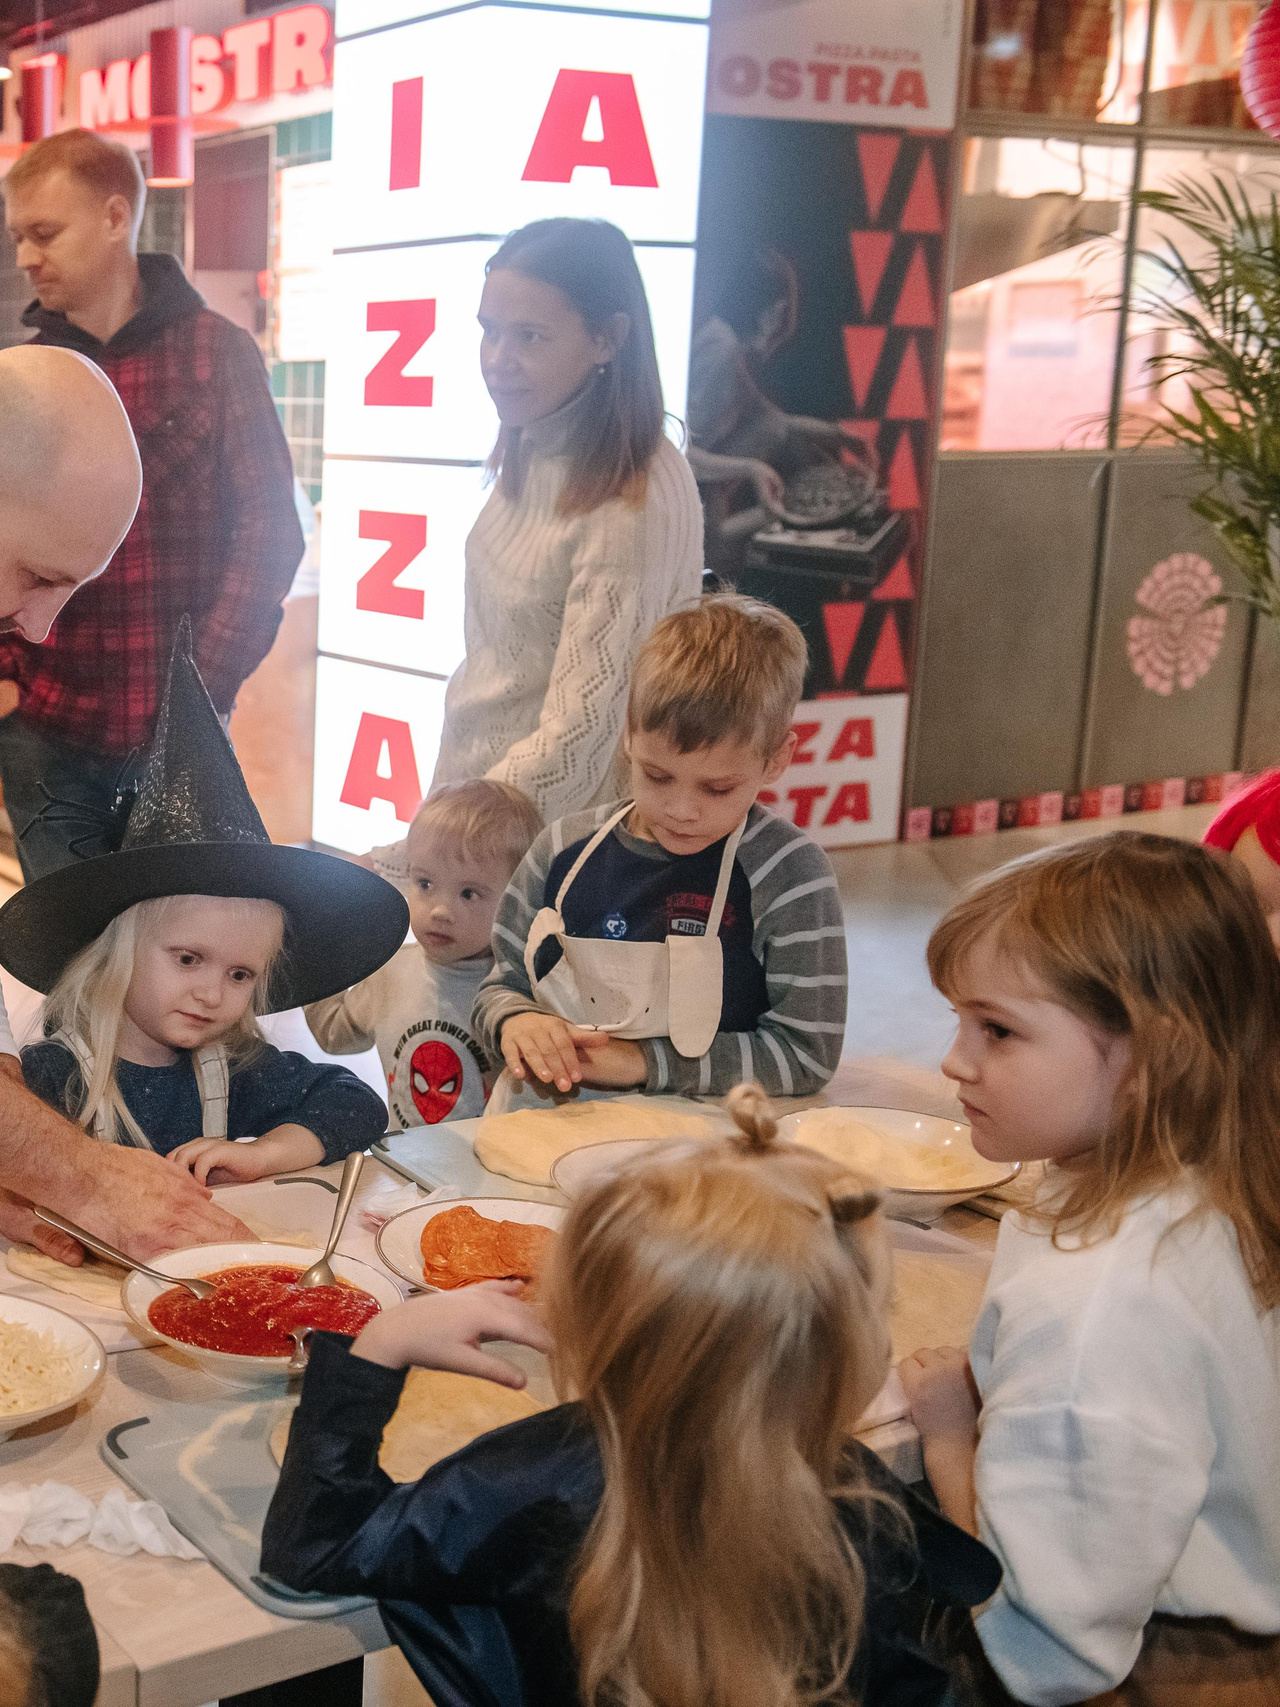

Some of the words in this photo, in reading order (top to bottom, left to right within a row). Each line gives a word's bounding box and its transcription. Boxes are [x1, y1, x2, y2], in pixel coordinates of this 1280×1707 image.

[521, 68, 659, 188] A
[406, 1019, 433, 1038] GREAT
[434, 1019, 471, 1044] POWER
